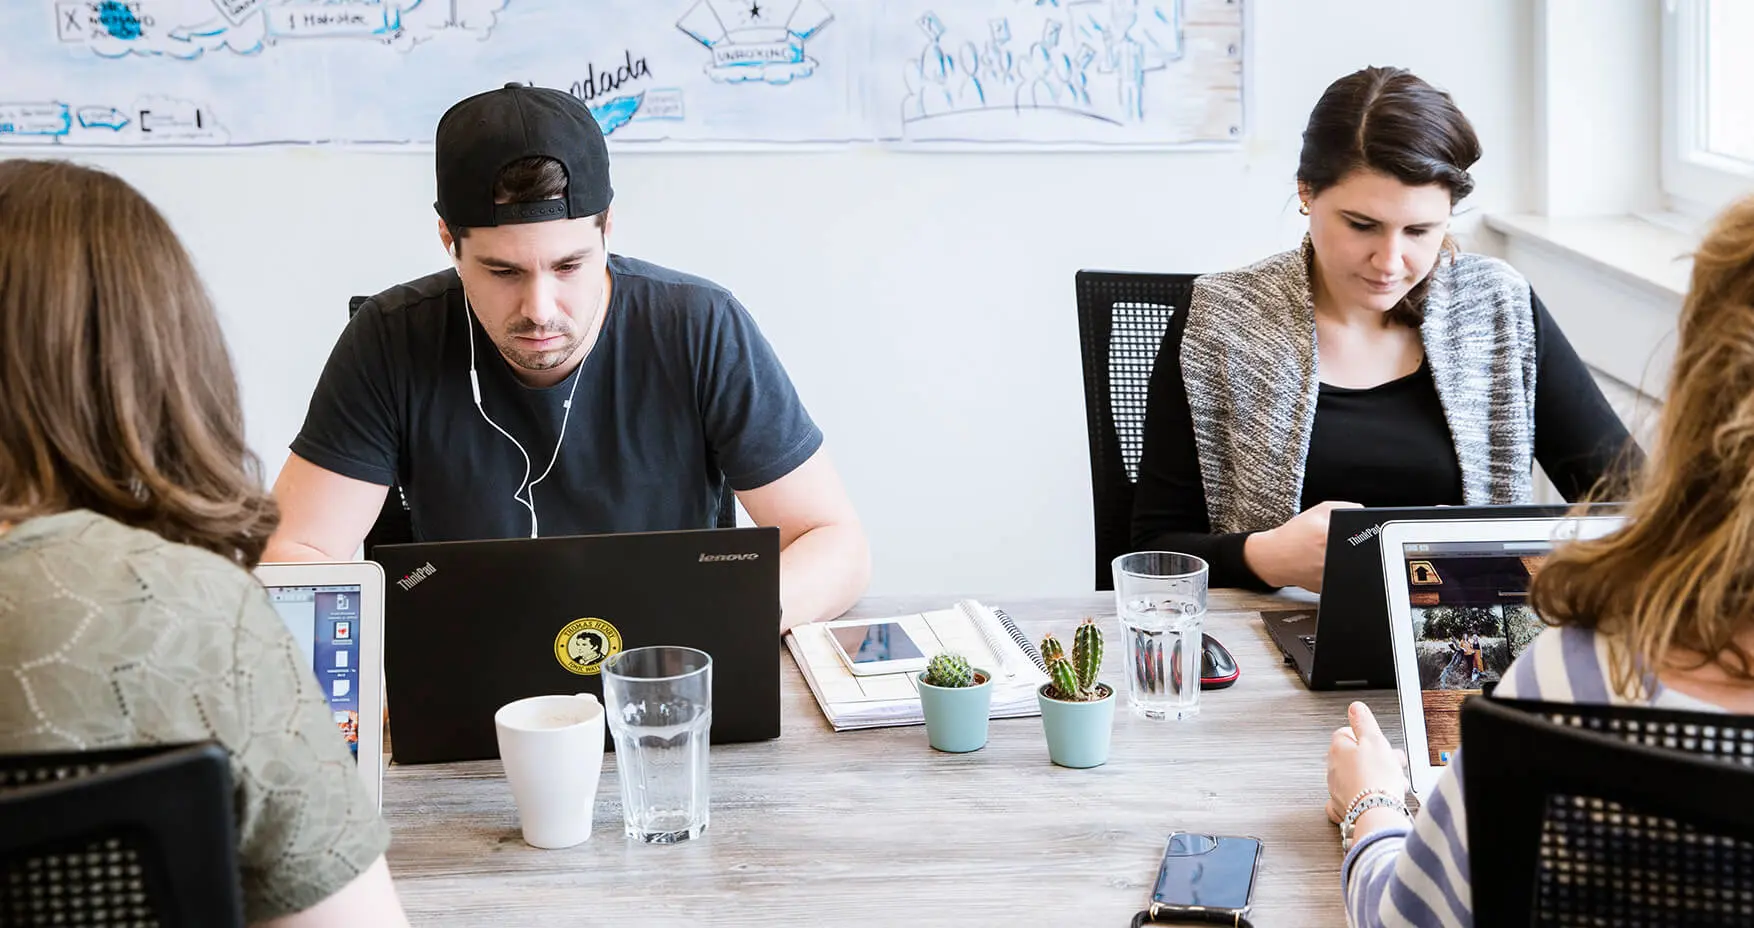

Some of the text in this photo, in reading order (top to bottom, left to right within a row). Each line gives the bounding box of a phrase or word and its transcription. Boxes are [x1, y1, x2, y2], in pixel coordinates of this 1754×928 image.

[1347, 523, 1381, 547] ThinkPad
[698, 552, 760, 563] lenovo
[396, 561, 437, 591] ThinkPad
[564, 621, 615, 639] THOMAS HENRY
